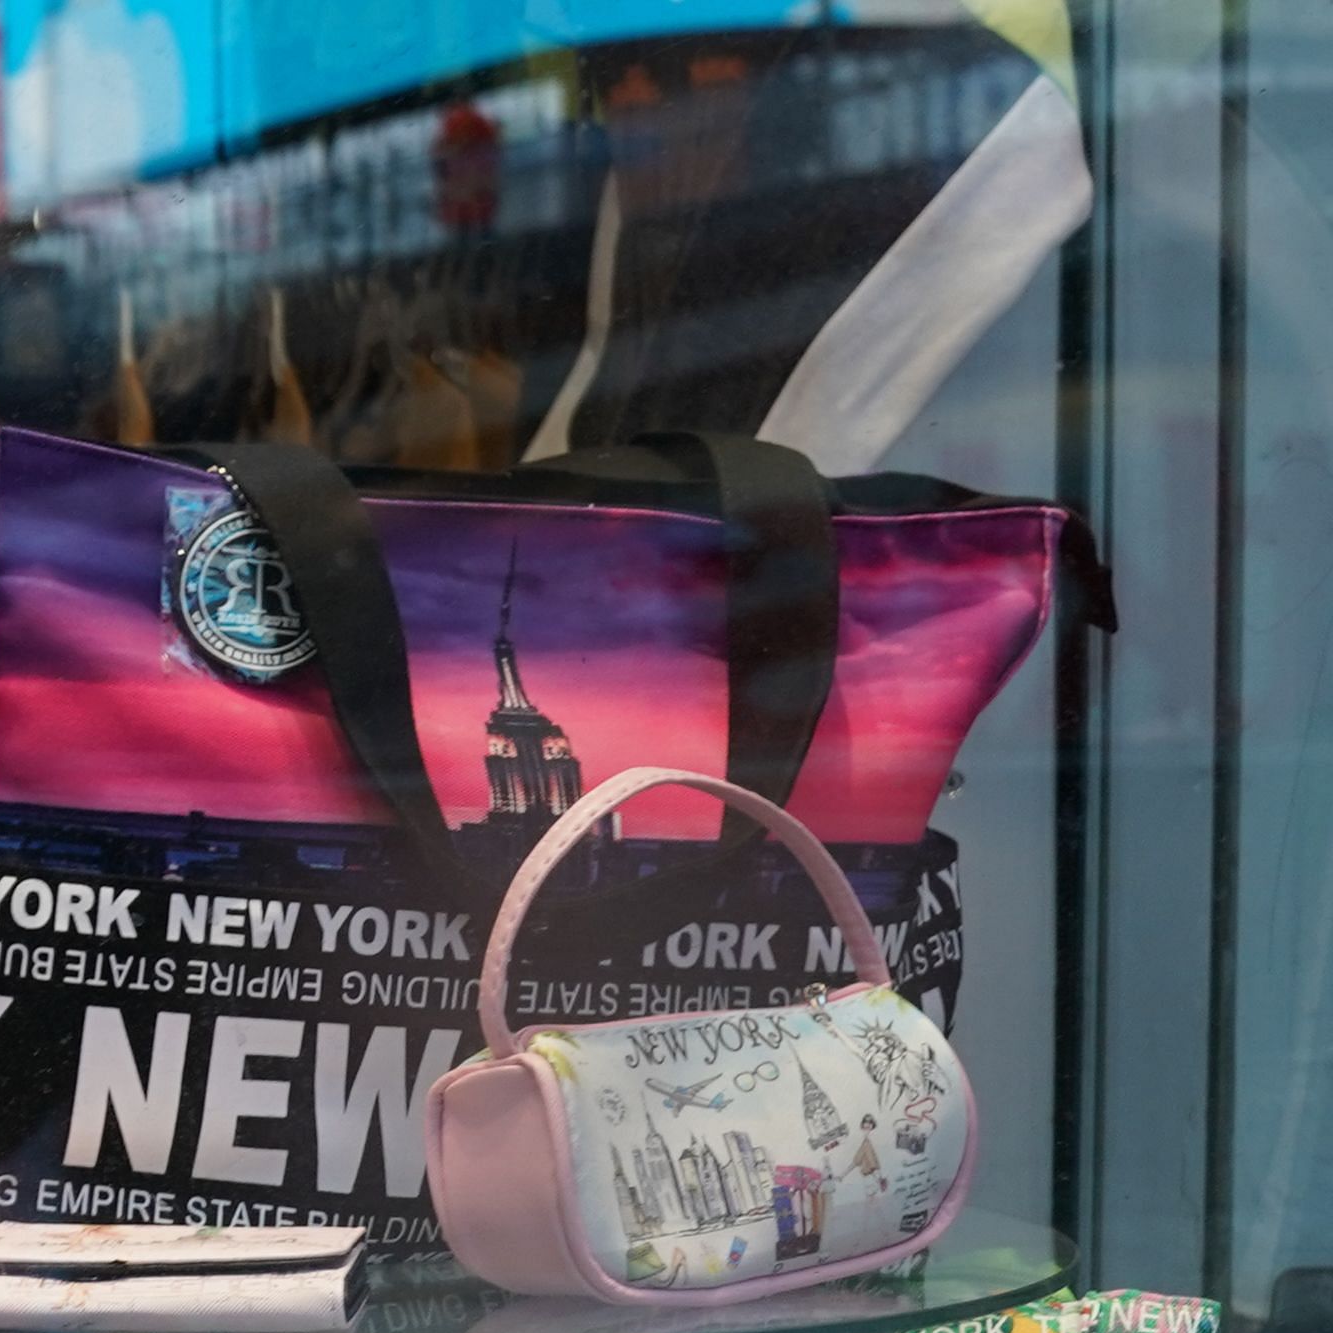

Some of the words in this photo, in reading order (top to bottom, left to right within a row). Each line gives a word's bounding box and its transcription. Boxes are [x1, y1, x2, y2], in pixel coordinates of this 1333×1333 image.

[167, 892, 301, 950] NEW
[313, 903, 470, 961] YORK
[64, 948, 177, 994] STATE
[185, 960, 323, 1002] EMPIRE
[693, 1013, 801, 1066] YORK
[61, 1005, 464, 1199] NEW
[36, 1178, 177, 1225] EMPIRE
